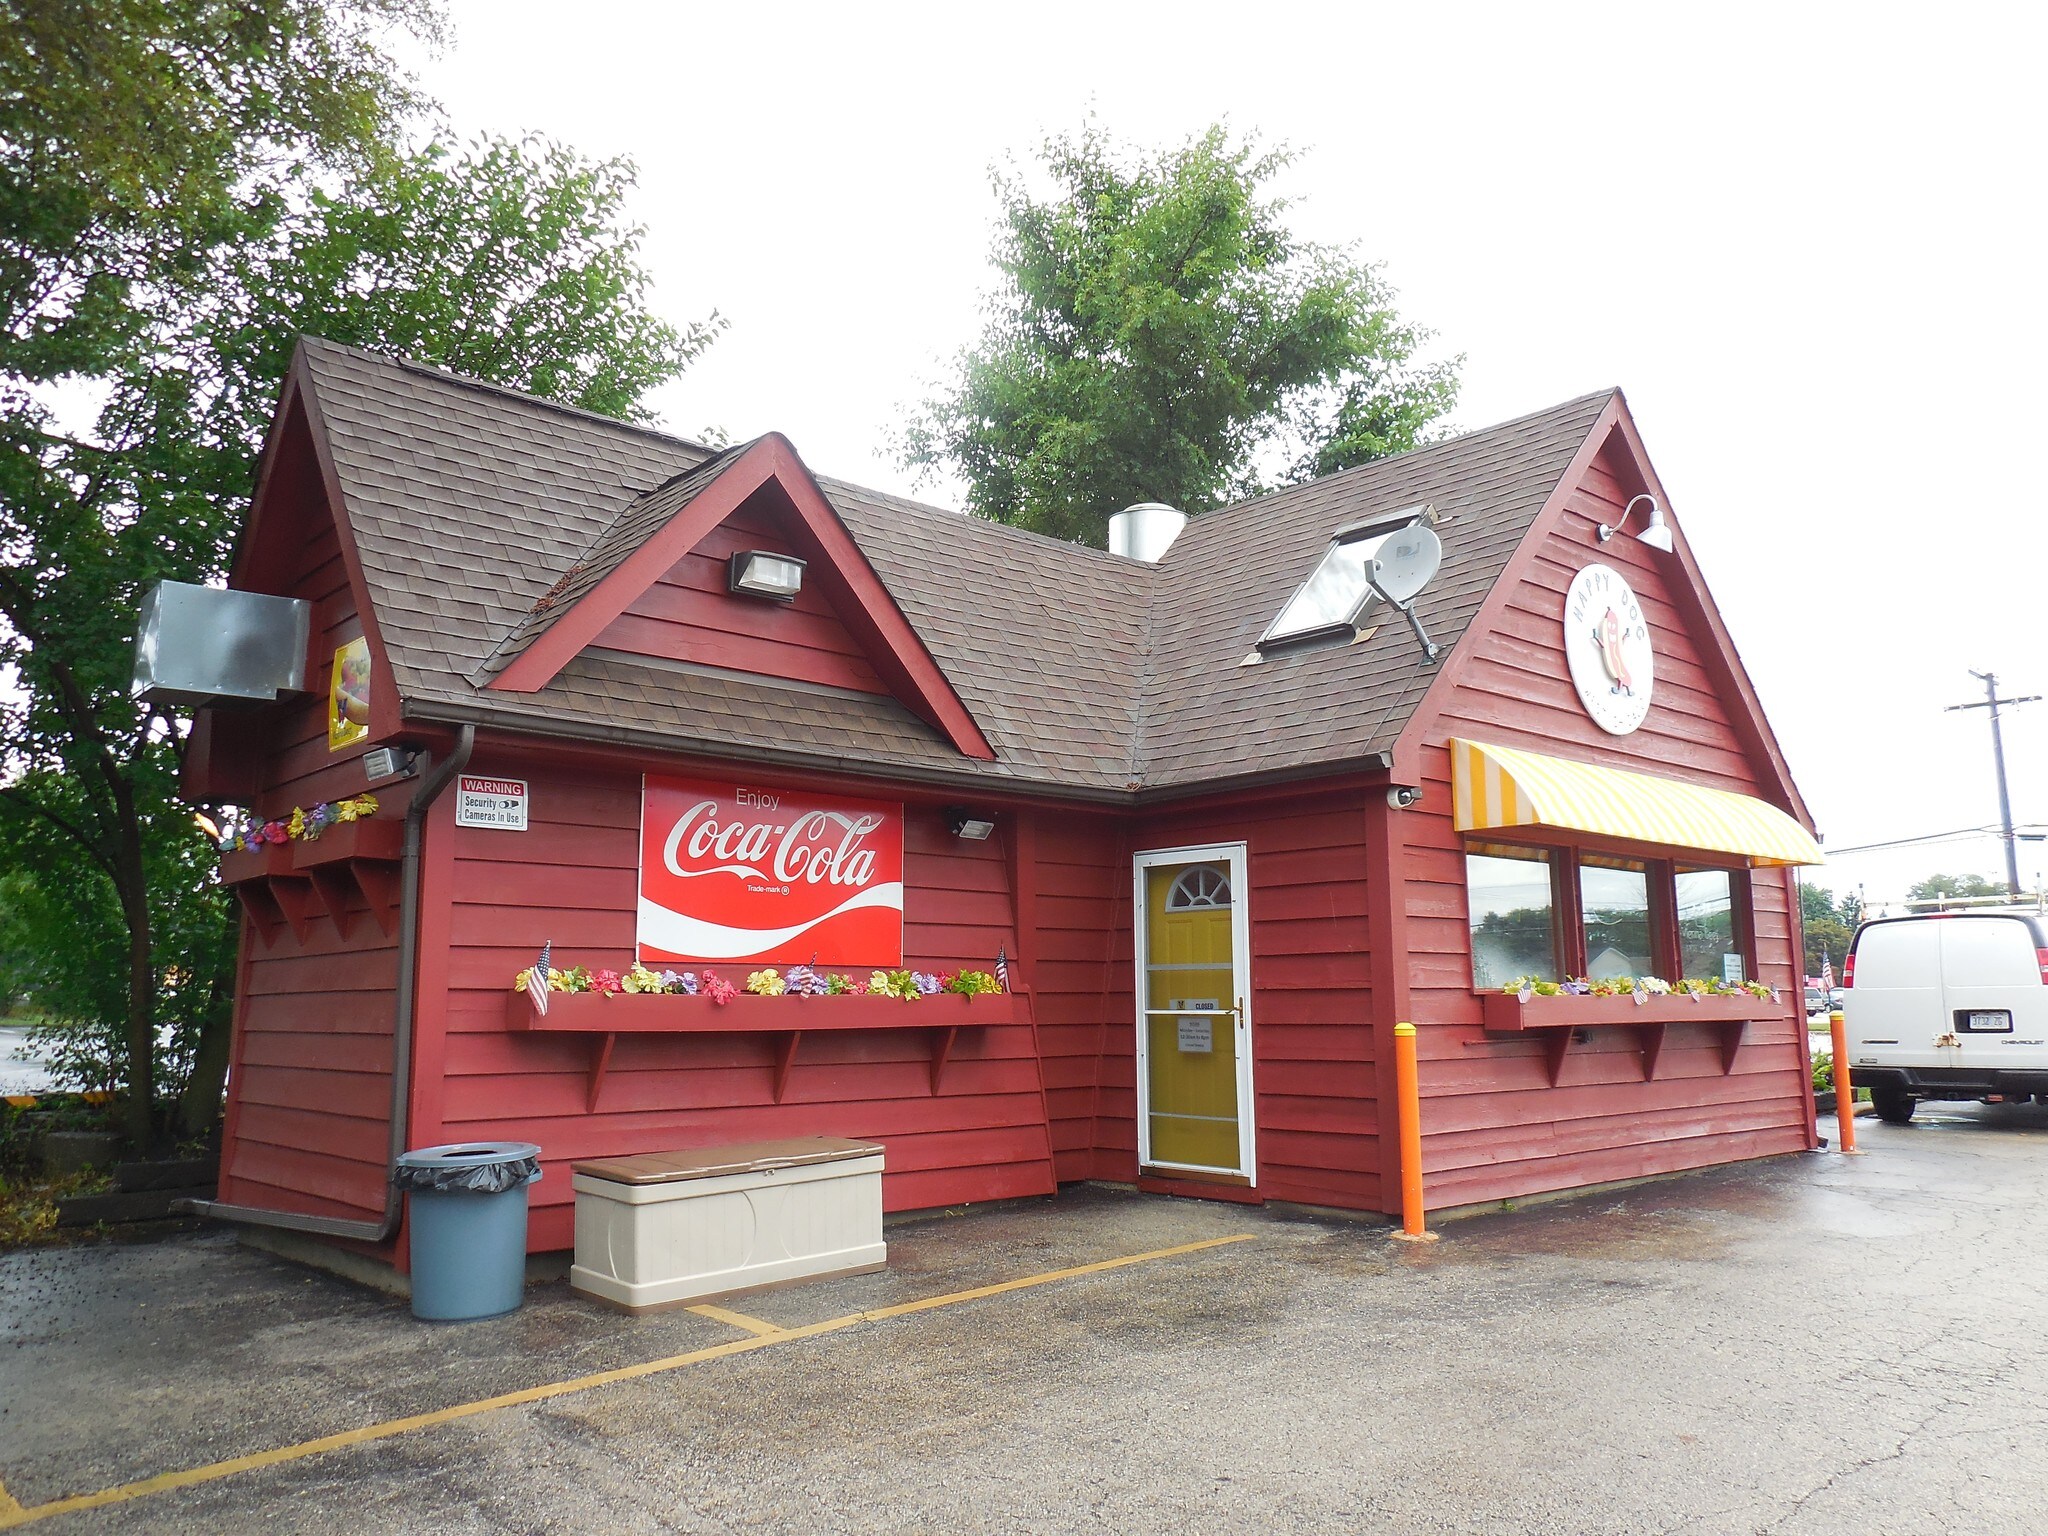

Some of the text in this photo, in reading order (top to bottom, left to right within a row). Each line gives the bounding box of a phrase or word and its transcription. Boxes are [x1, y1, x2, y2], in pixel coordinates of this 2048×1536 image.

[1573, 573, 1645, 641] HAPPY DOG
[464, 779, 521, 795] WARNING
[465, 796, 497, 810] Security
[736, 788, 780, 811] Enjoy
[464, 808, 519, 824] Cameras In Use
[663, 800, 885, 886] Coca-Cola
[747, 884, 781, 893] Trade-mark
